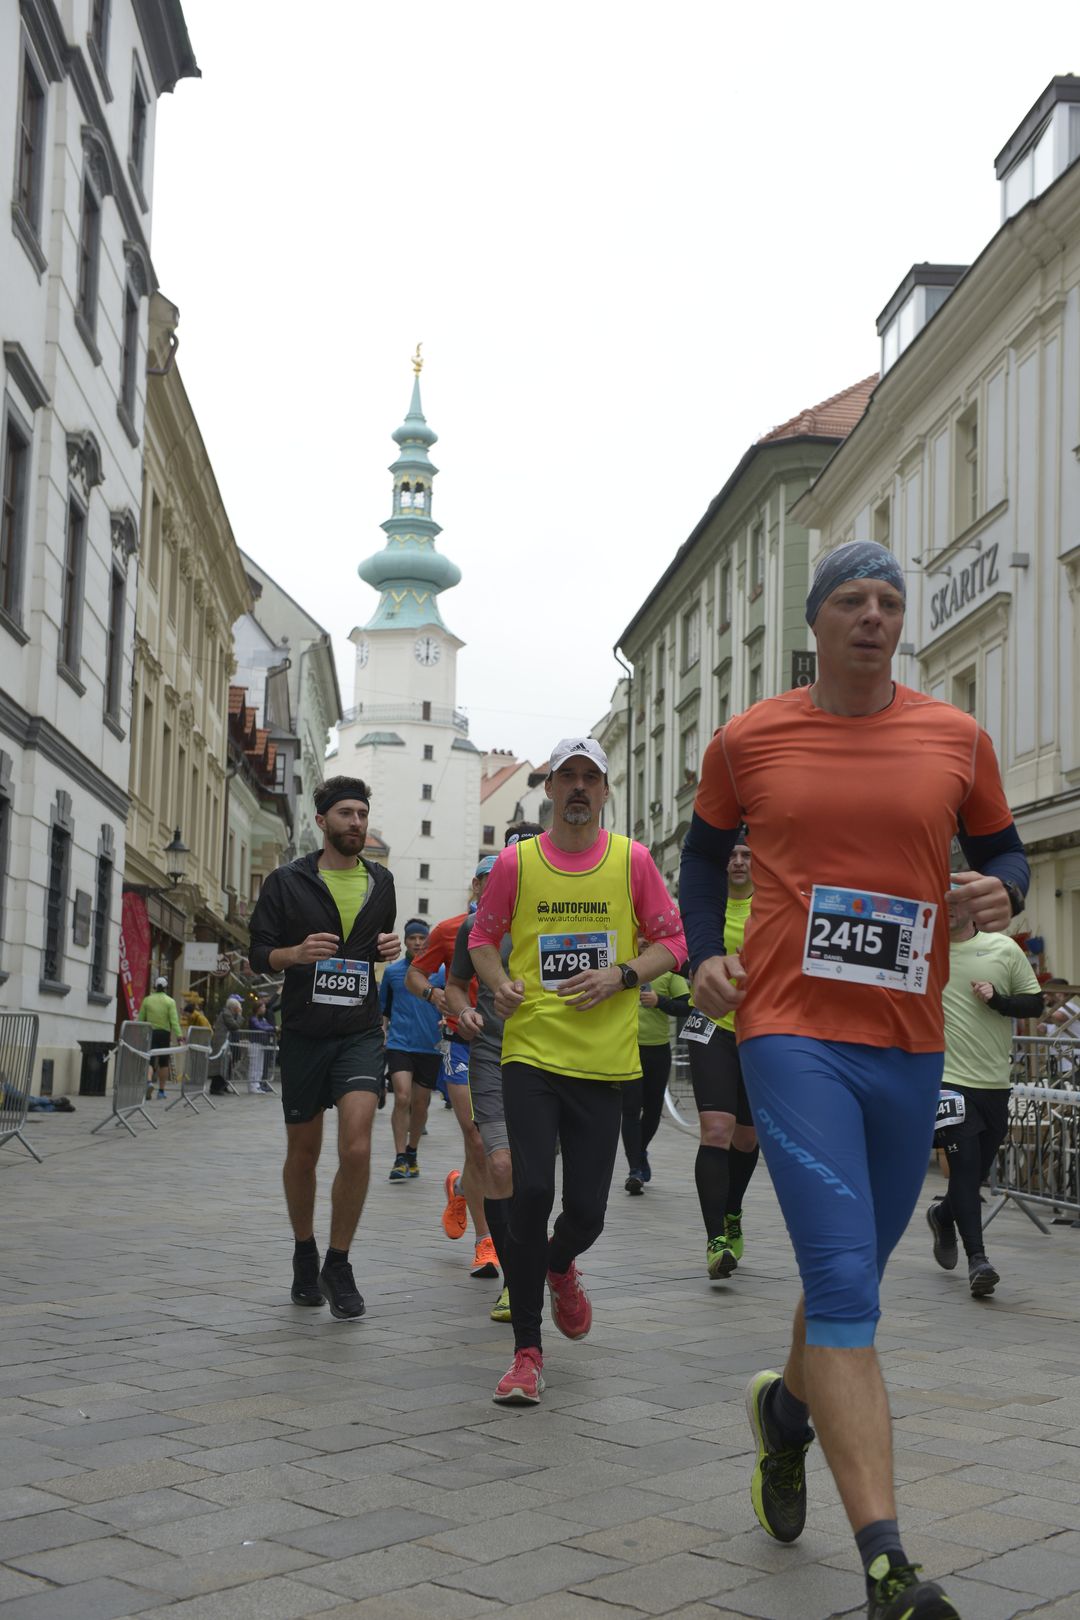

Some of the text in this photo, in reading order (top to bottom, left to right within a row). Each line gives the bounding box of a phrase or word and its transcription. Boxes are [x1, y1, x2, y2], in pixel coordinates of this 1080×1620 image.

[930, 542, 999, 631] SKARITZ
[551, 902, 608, 914] AUTOFUNIA
[537, 915, 611, 923] www.autofunia.com
[811, 918, 883, 955] 2415
[543, 952, 591, 972] 4798
[823, 953, 844, 962] DANIEL
[316, 973, 356, 991] 4698
[914, 966, 924, 988] 2415
[936, 1101, 951, 1116] 41
[757, 1107, 857, 1200] DYNAFIT
